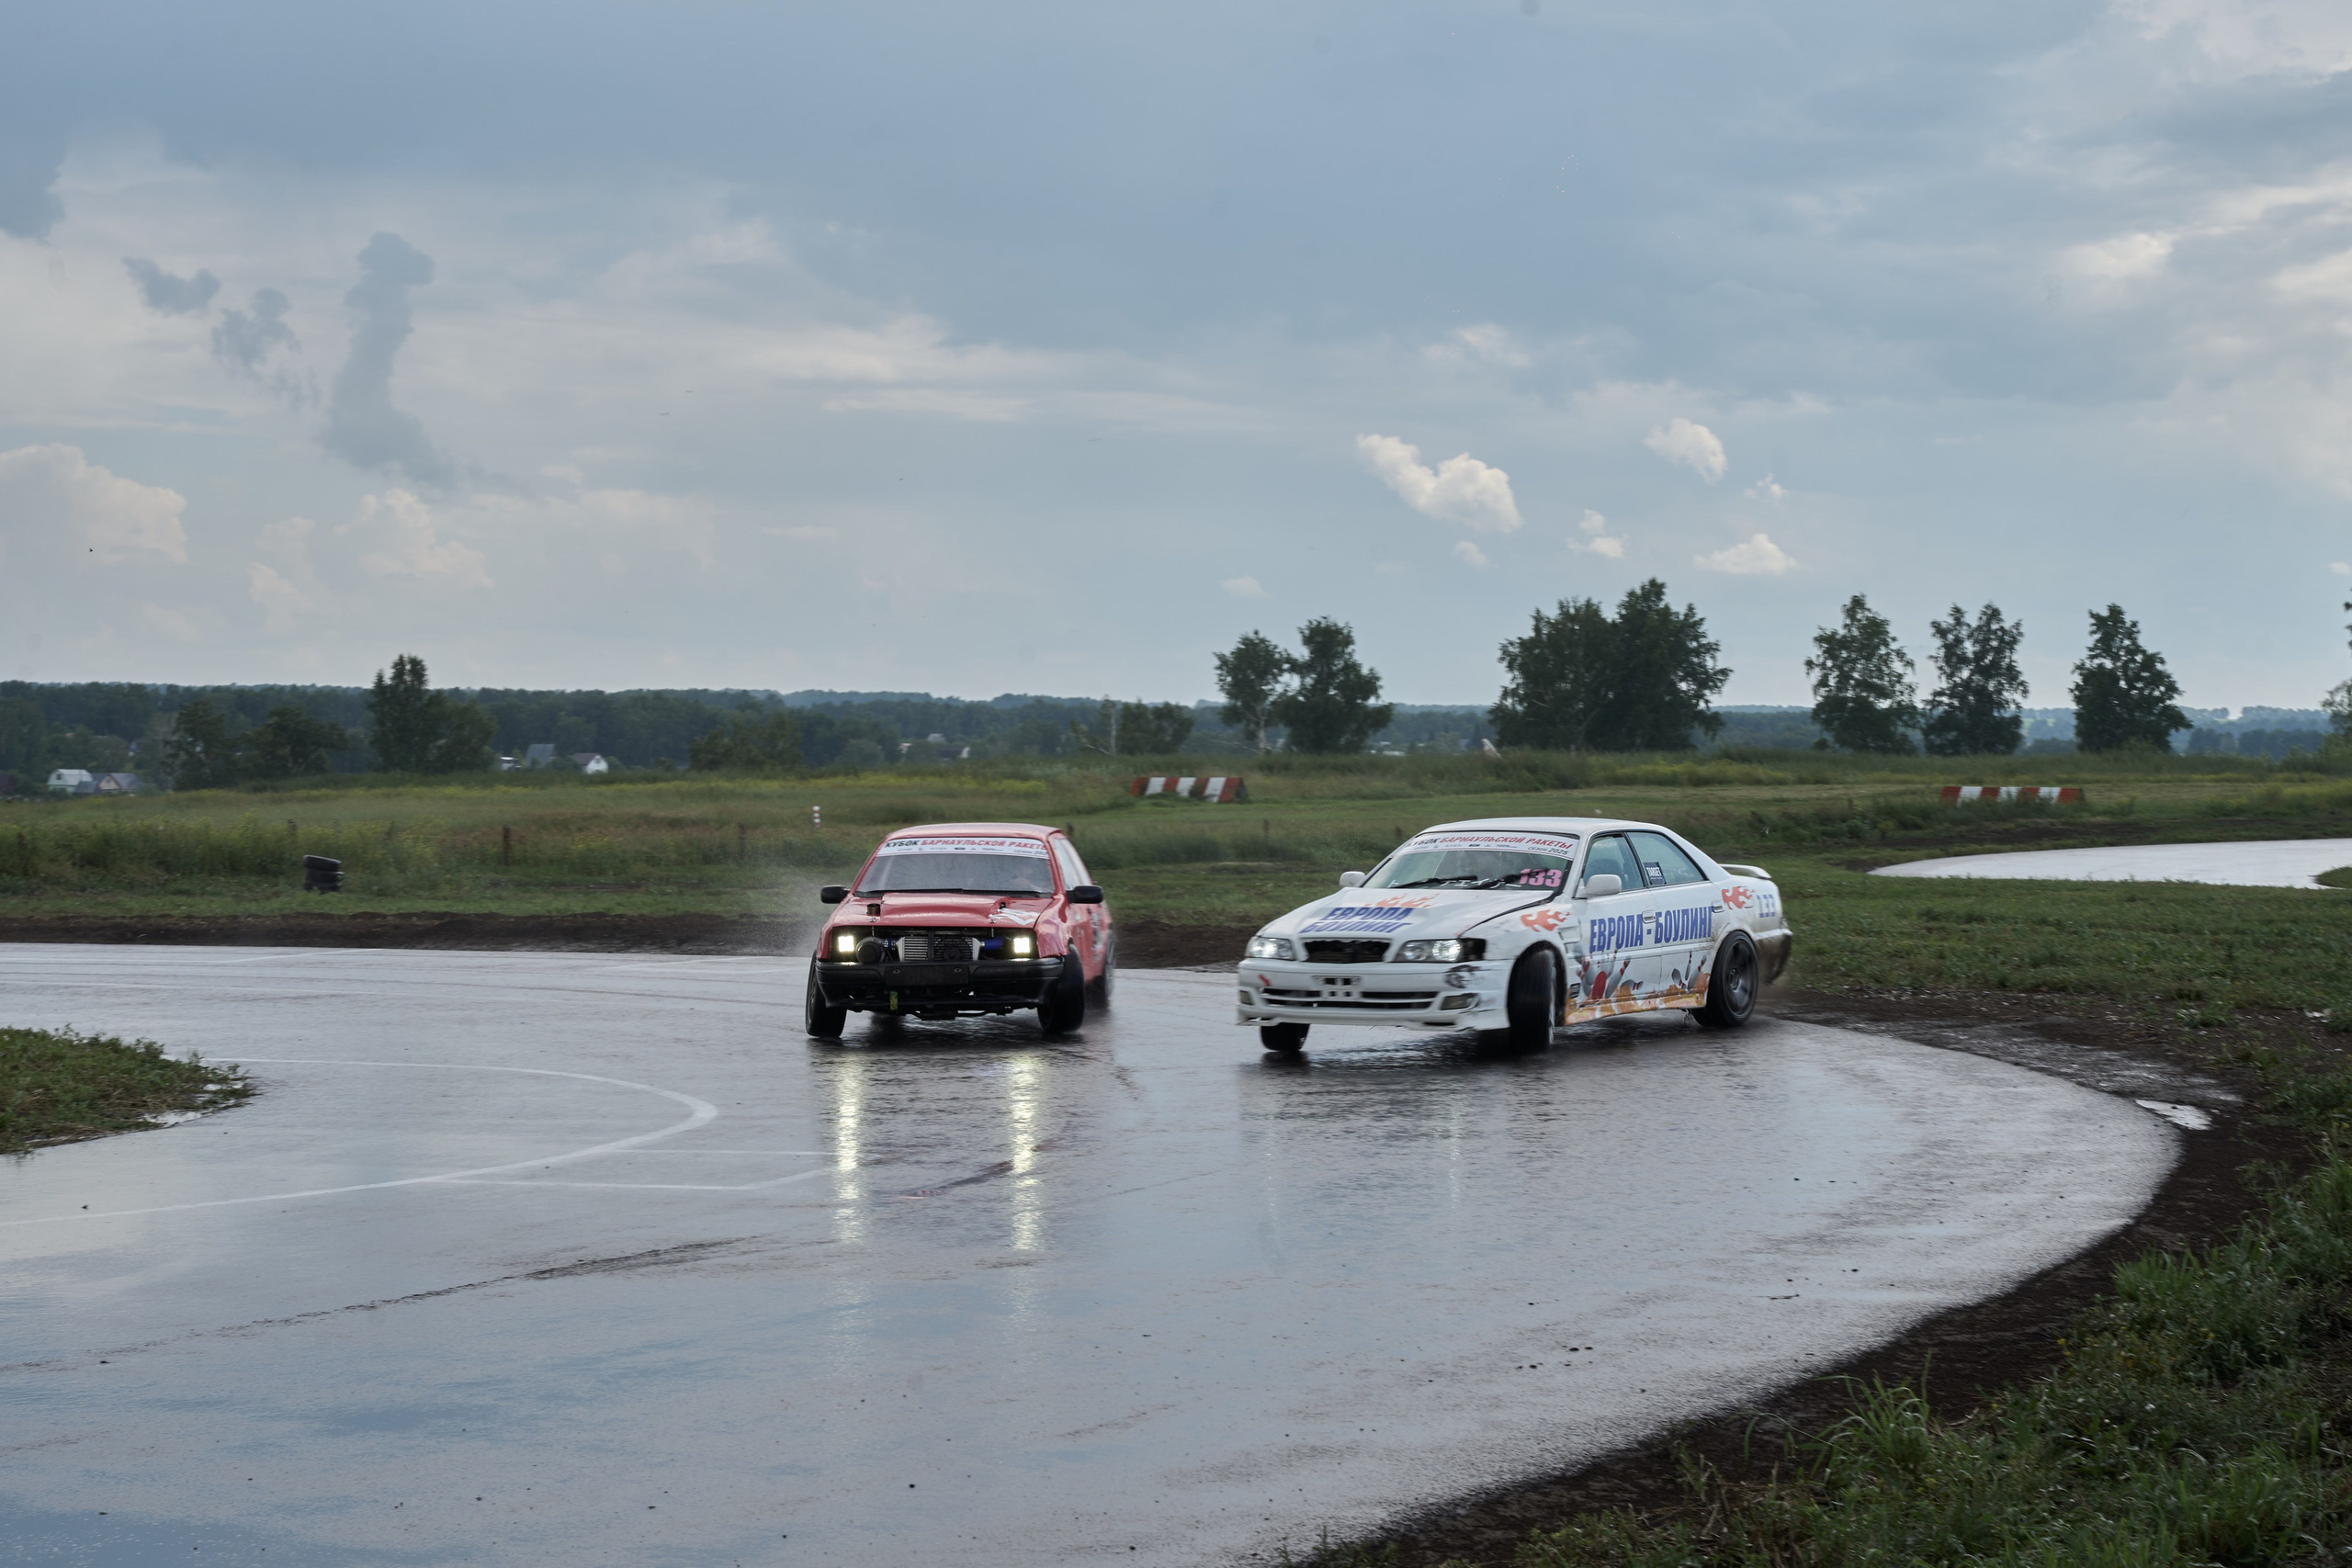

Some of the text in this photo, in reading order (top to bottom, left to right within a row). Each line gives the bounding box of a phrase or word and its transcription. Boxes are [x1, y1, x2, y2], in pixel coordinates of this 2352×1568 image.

[885, 840, 920, 848] КУБОК
[1525, 838, 1573, 849] РАКЕТЫ
[1519, 868, 1563, 887] 133
[1319, 907, 1415, 920] ЕВРОПА
[1298, 921, 1413, 934] БОУЛИНГ
[1589, 913, 1644, 953] ЕВРОПА
[1654, 906, 1713, 944] БОУЛИНГ
